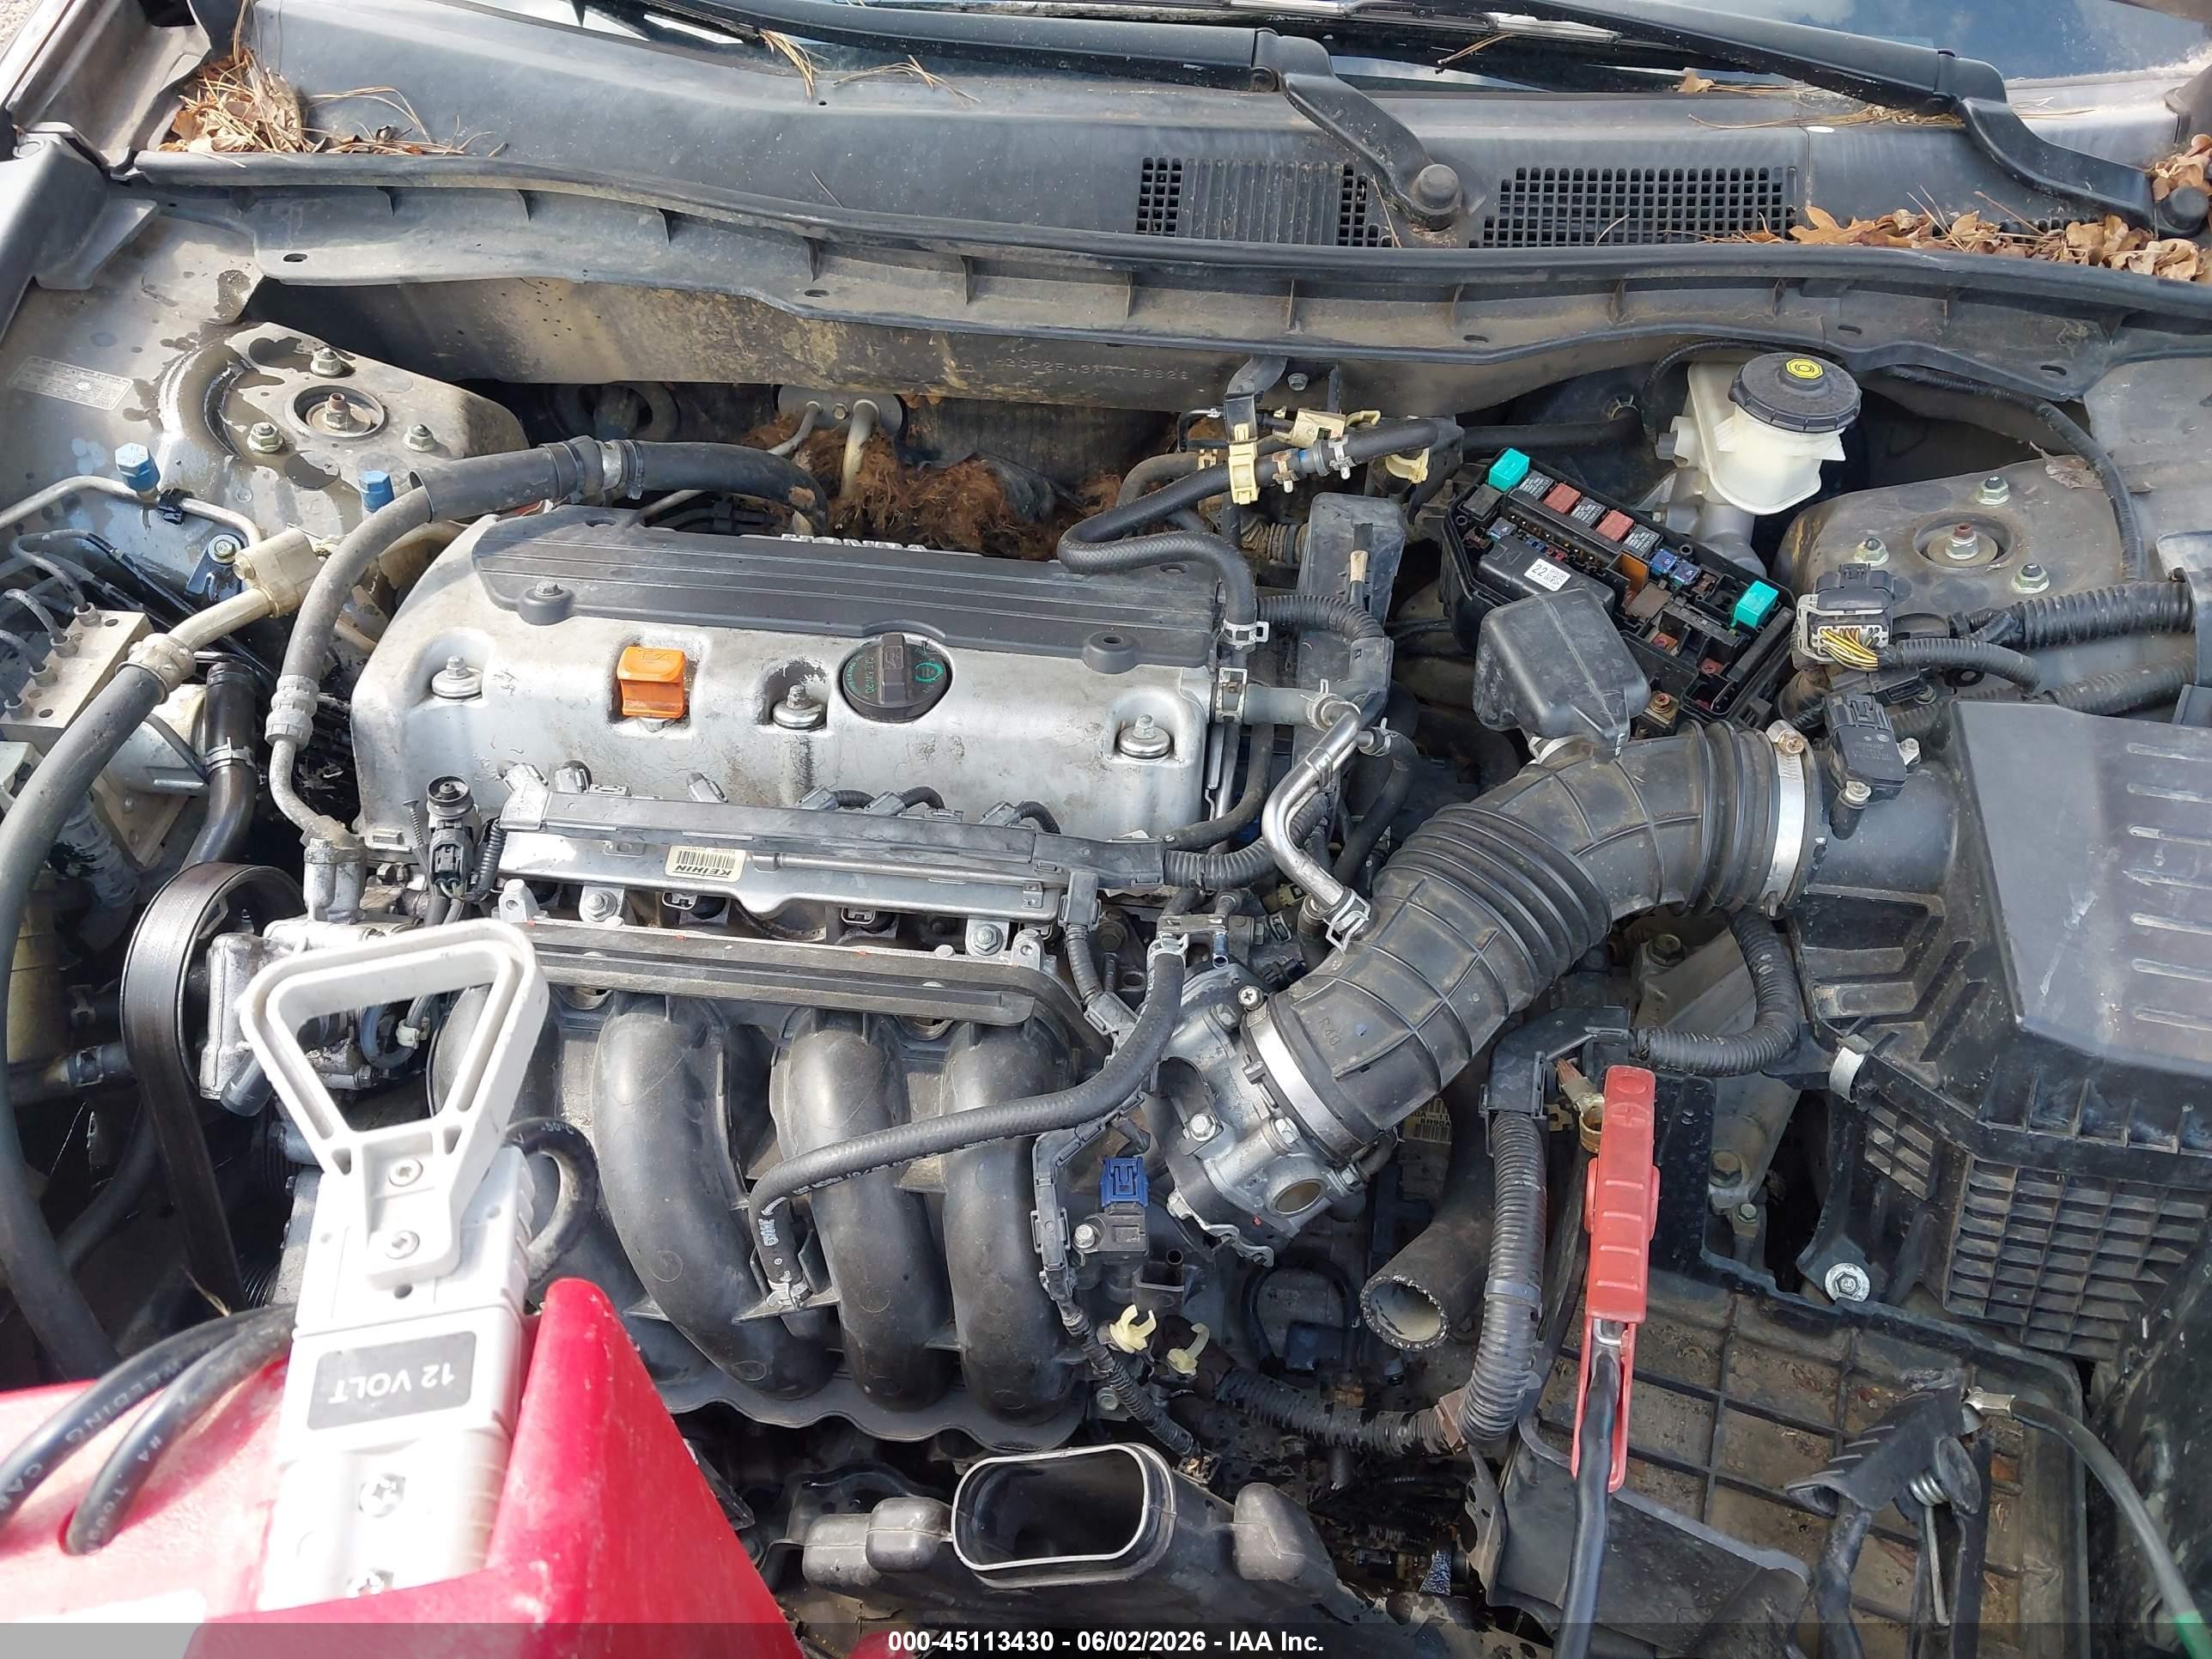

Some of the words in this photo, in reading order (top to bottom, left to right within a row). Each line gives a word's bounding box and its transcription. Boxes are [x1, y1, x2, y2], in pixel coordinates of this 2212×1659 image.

[676, 865, 732, 876] KEIHIN
[327, 1369, 412, 1404] VOLT
[420, 1362, 455, 1389] 12
[65, 1360, 182, 1443] WELDING
